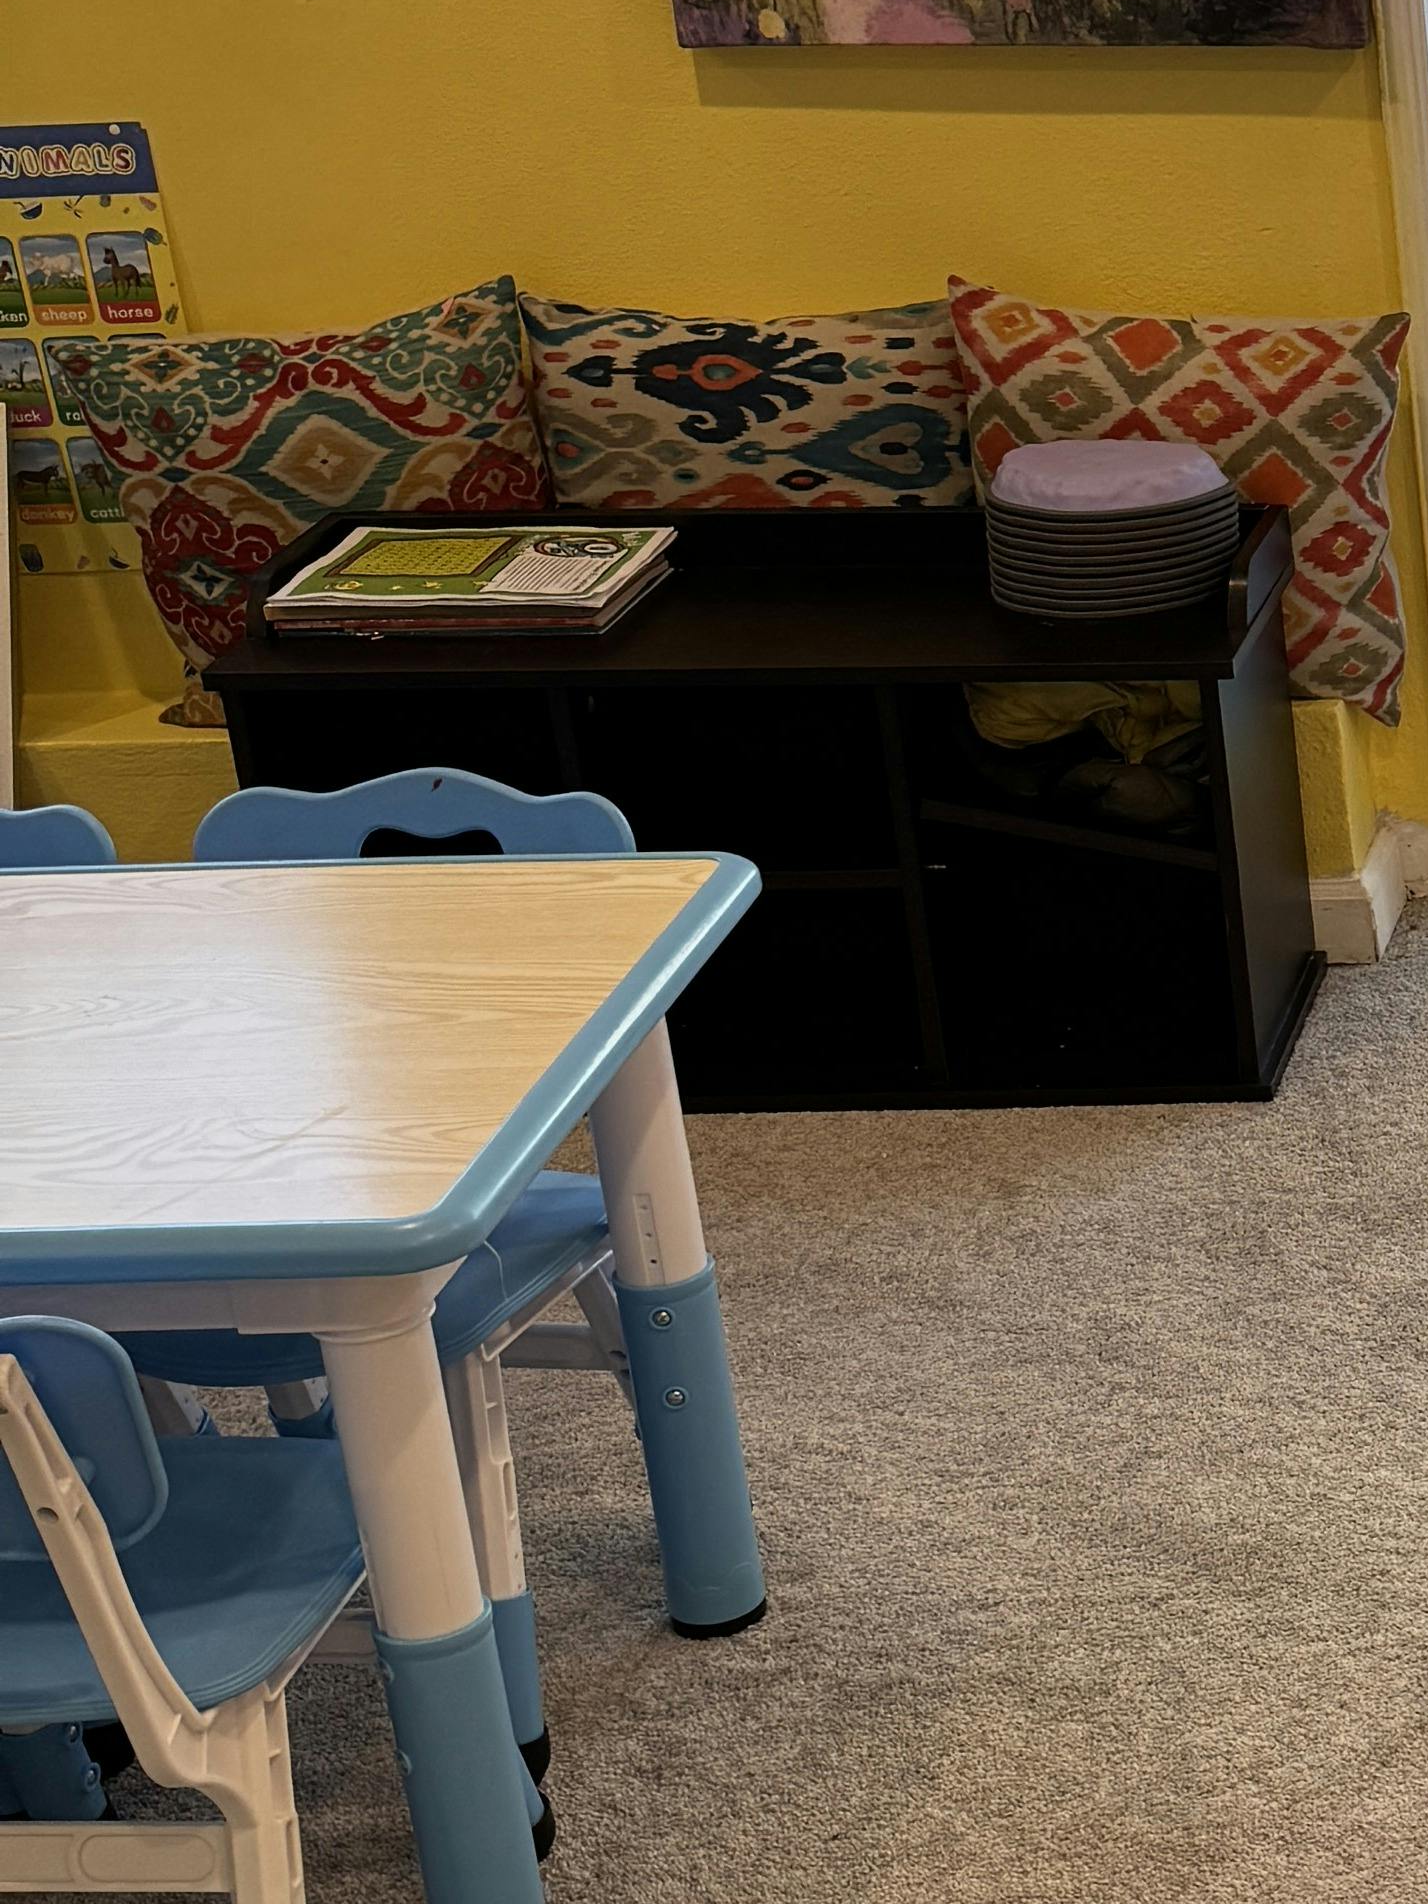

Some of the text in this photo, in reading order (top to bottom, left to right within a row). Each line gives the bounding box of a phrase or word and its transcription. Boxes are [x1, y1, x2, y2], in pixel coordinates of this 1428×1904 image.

[41, 307, 88, 322] sheep
[108, 303, 154, 319] horse
[22, 508, 75, 522] donkey
[90, 507, 126, 519] cattl
